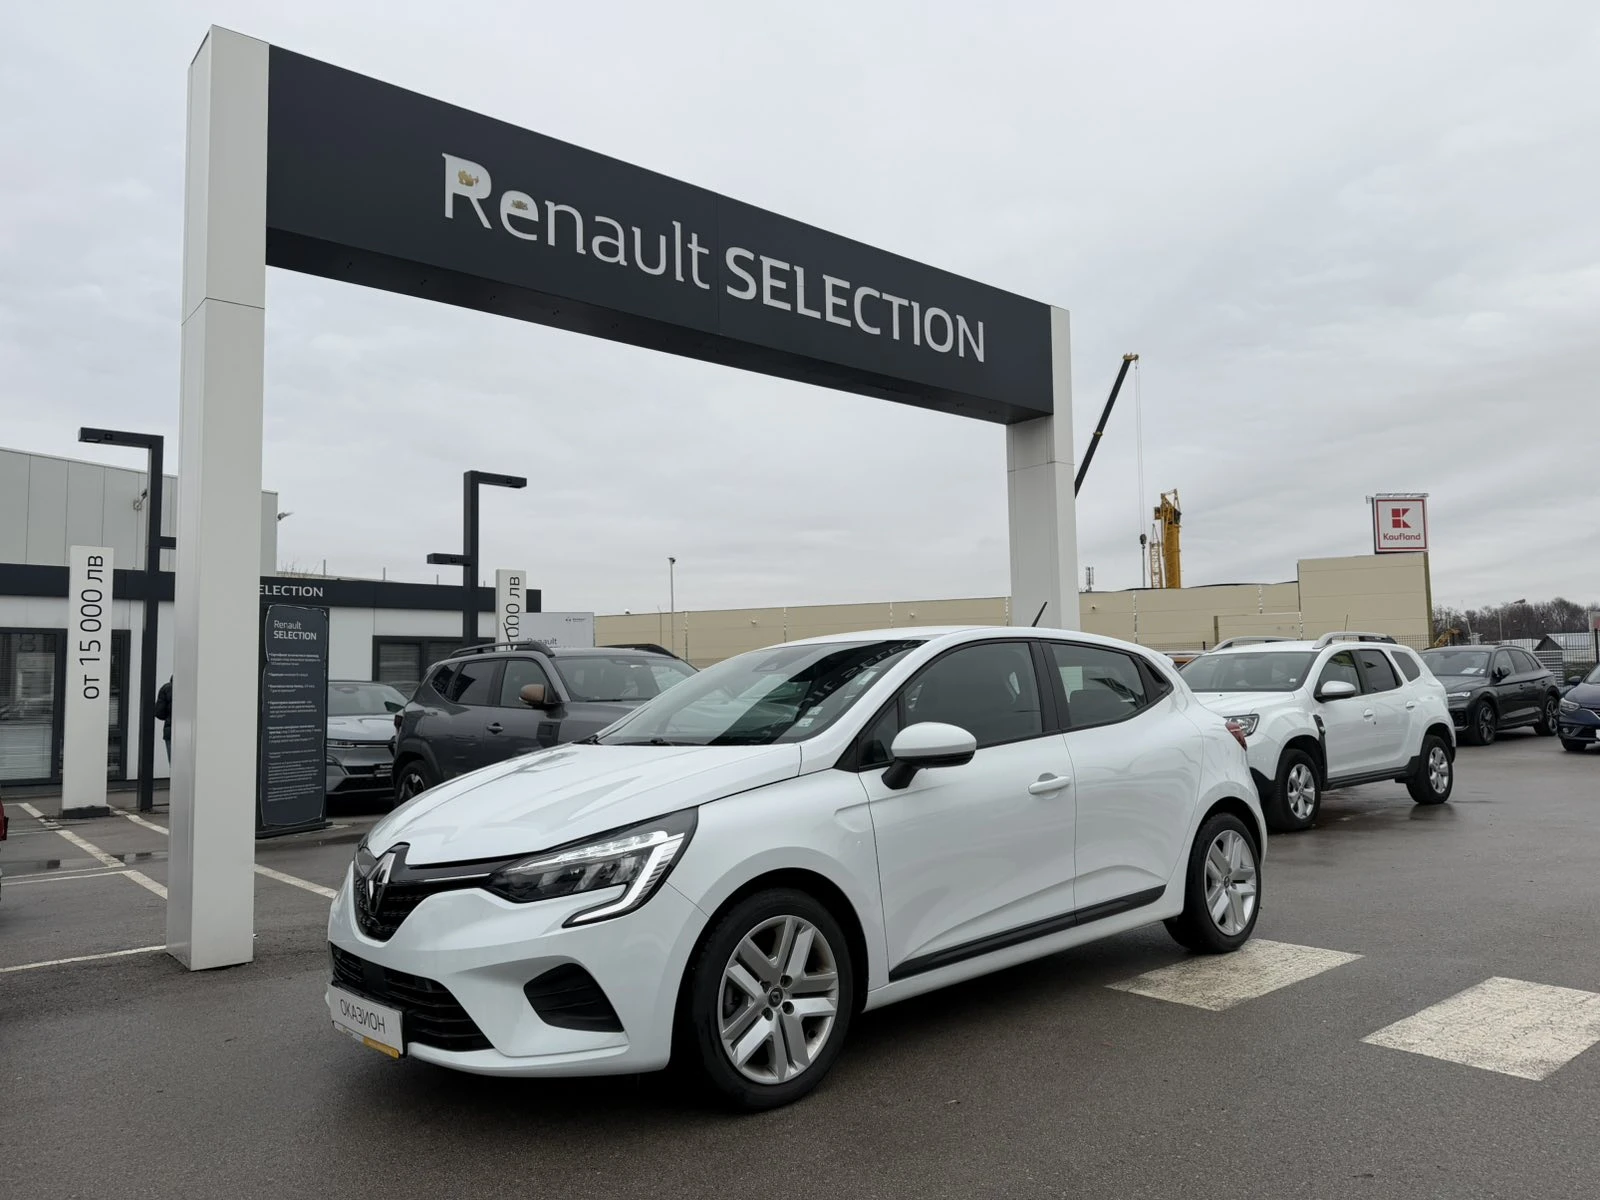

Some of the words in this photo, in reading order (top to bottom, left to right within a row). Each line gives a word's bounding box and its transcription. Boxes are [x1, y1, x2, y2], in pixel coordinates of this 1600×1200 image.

[442, 153, 710, 290] Renault
[725, 247, 985, 363] SELECTION
[1383, 533, 1421, 541] Kaufland
[87, 555, 104, 583] лв
[509, 576, 520, 598] лв
[80, 589, 103, 632] 000
[273, 619, 302, 630] Renault
[273, 630, 317, 641] SELECTION
[79, 640, 101, 666] 15
[341, 999, 386, 1034] ОКАЗИОН
